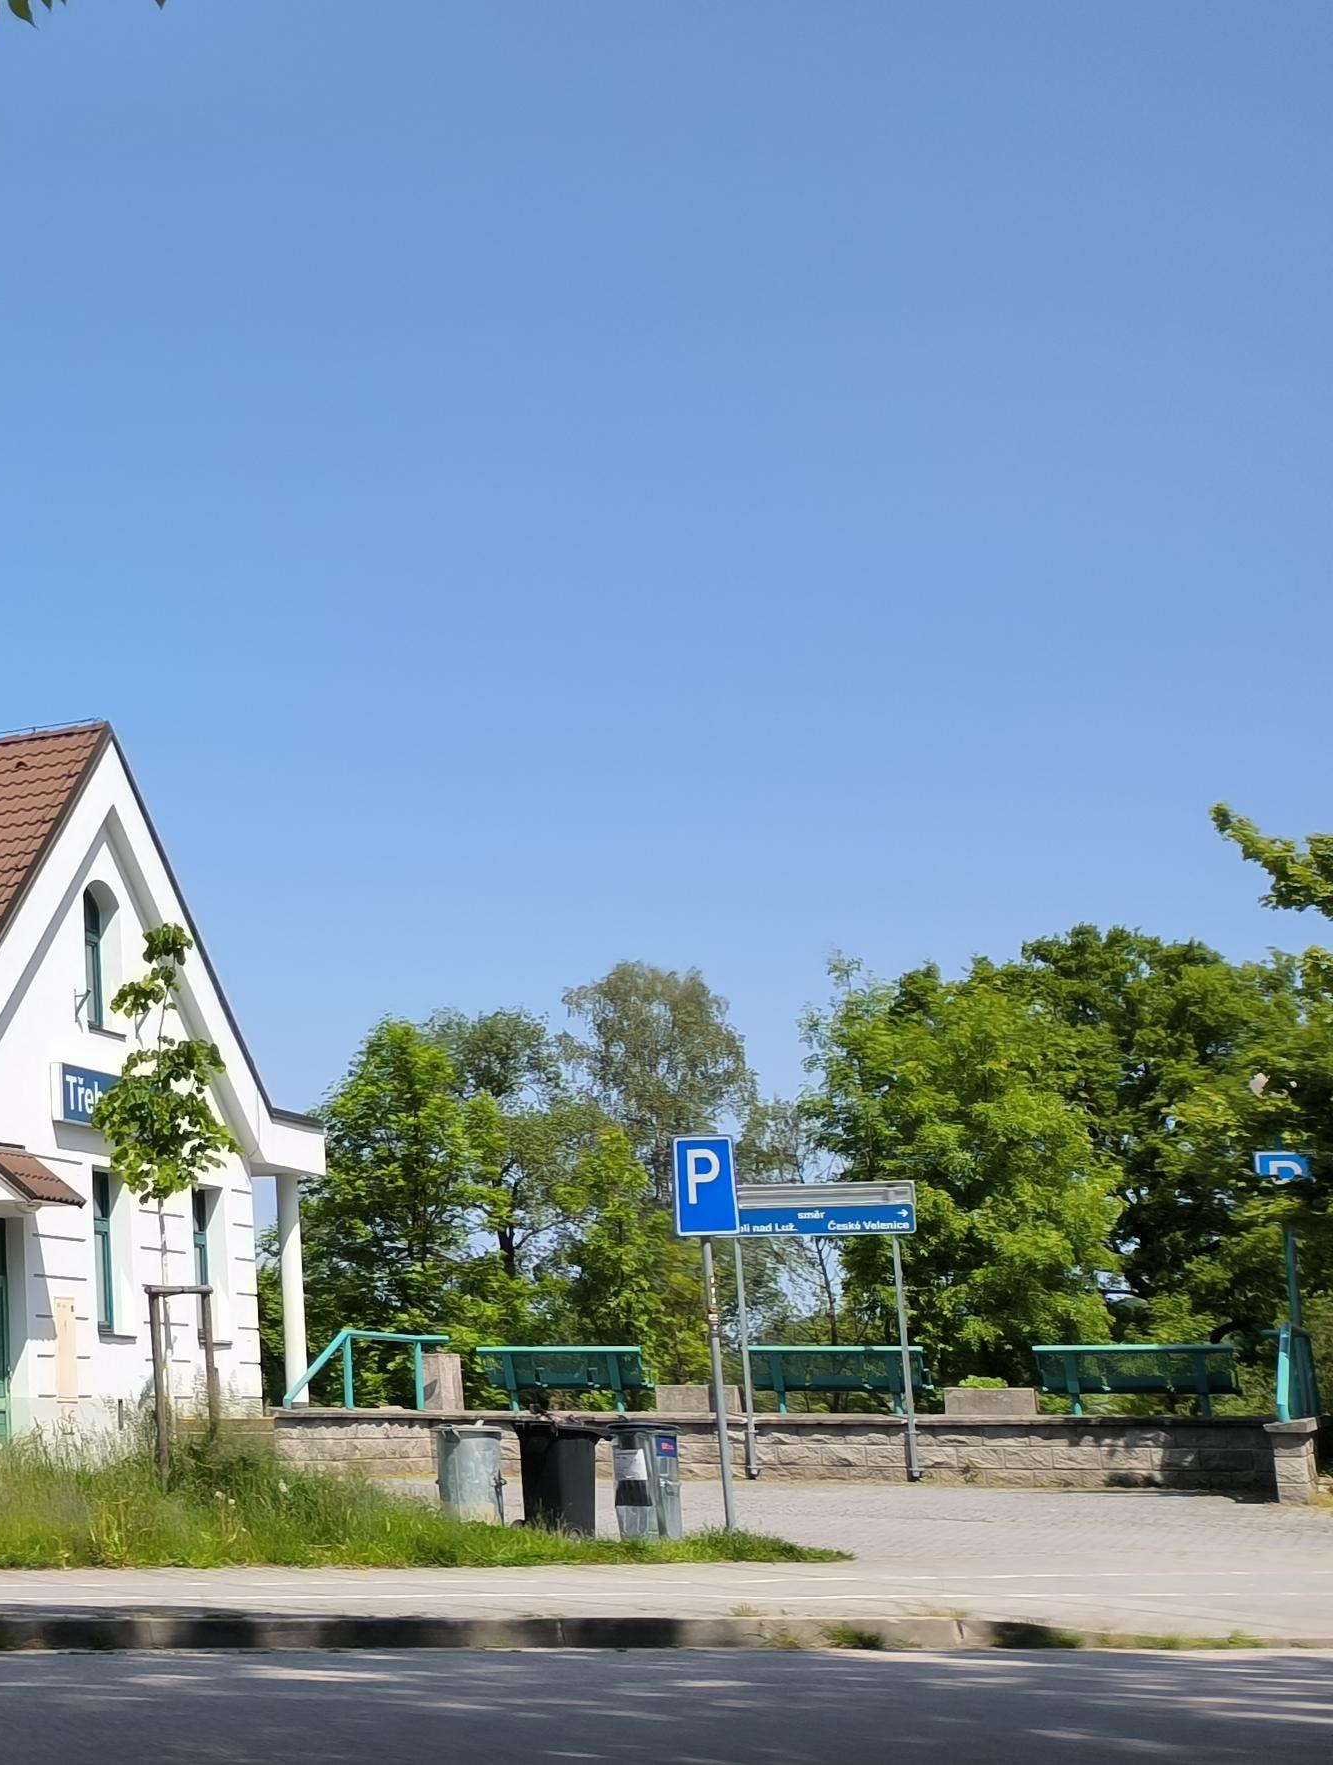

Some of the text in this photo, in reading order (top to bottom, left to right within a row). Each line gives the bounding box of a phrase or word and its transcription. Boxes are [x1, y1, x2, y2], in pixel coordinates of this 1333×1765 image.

[686, 1148, 720, 1204] P
[797, 1210, 826, 1219] směr
[752, 1223, 773, 1233] nad
[827, 1219, 910, 1231] České Velenice
